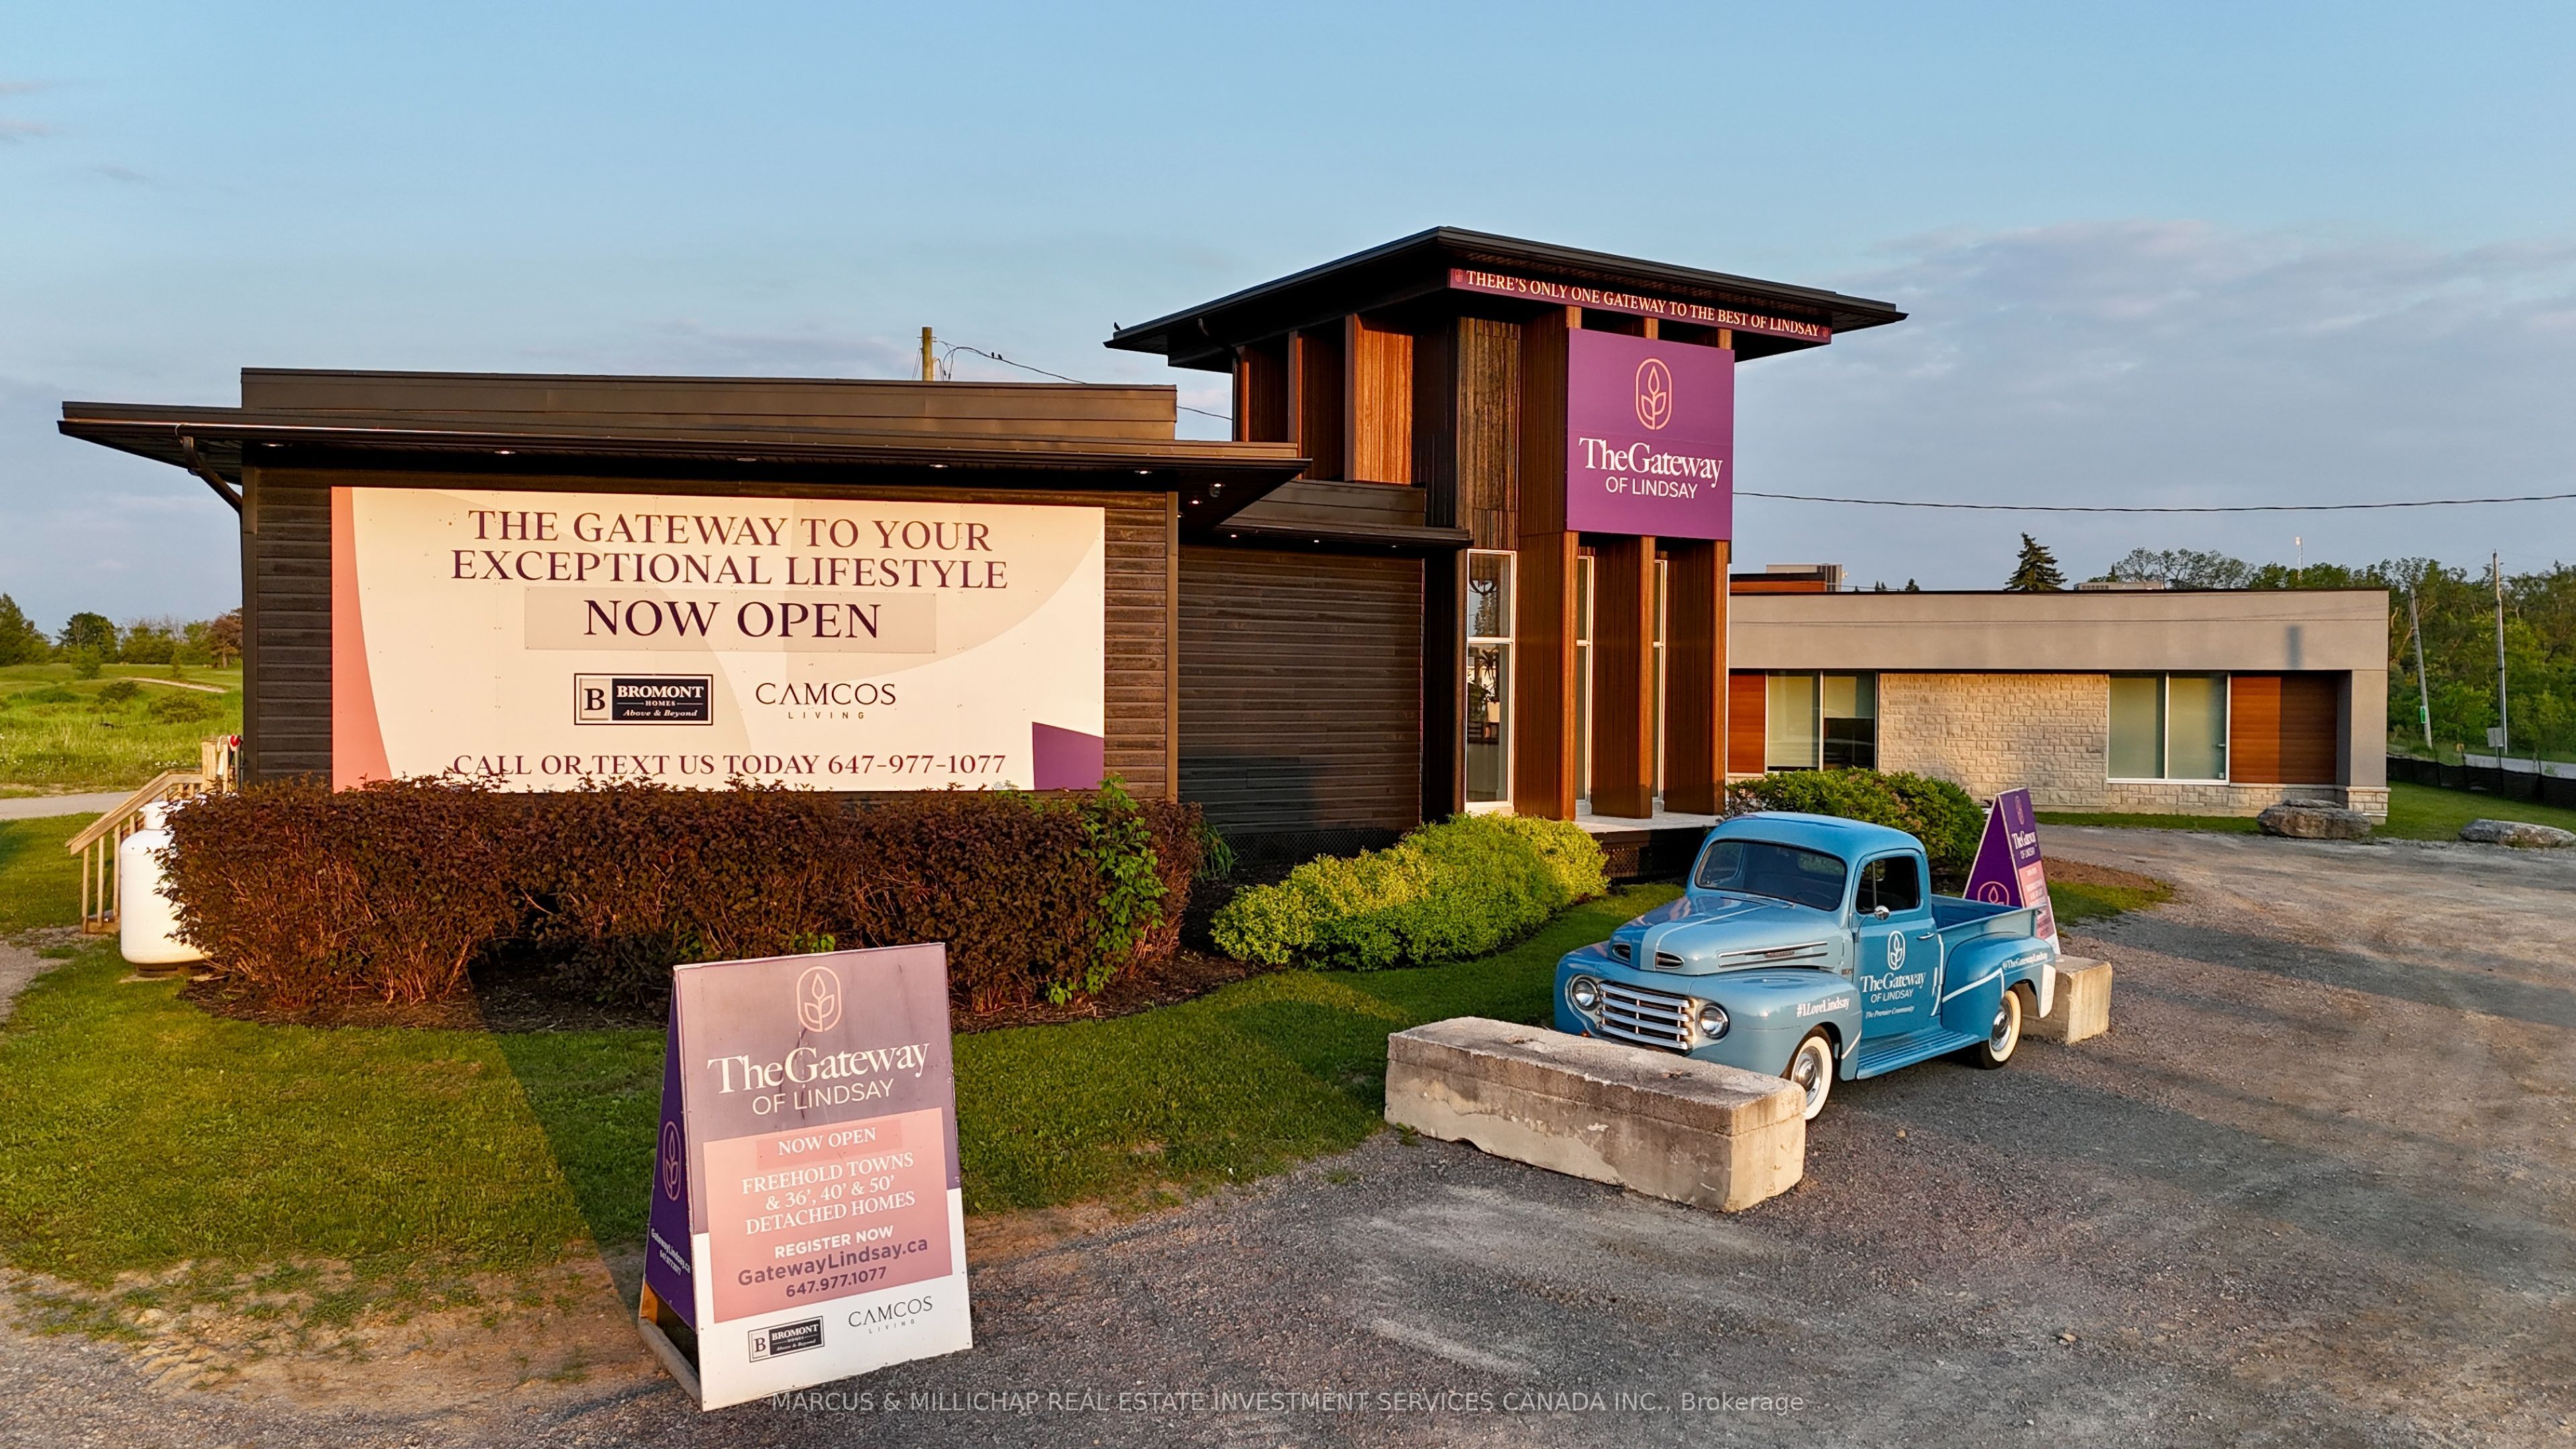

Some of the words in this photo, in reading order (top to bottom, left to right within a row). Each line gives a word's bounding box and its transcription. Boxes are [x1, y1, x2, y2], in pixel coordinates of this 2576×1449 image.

[1466, 270, 1526, 292] THERE'S
[1530, 280, 1568, 299] ONLY
[1571, 286, 1600, 304] ONE
[1603, 291, 1666, 314] GATEWAY
[1669, 301, 1687, 317] TO
[1690, 304, 1715, 321] THE
[1717, 309, 1748, 326] BEST
[1751, 315, 1768, 329] OF
[1770, 317, 1819, 337] LINDSAY
[1578, 437, 1723, 488] TheGateway
[1605, 476, 1628, 493] OF
[1632, 478, 1698, 499] LINDSAY
[468, 510, 559, 541] THE
[574, 512, 788, 547] GATEWAY
[800, 518, 859, 548] TO
[872, 520, 993, 551] YOUR
[451, 549, 772, 584] EXCEPTIONAL
[786, 557, 1008, 589] LIFESTYLE
[583, 600, 721, 637] NOW
[737, 601, 881, 638] OPEN
[584, 688, 605, 710] B
[616, 686, 704, 698] BROMONT
[755, 682, 896, 705] CAMCOS
[663, 709, 698, 718] Beyond
[788, 711, 864, 719] LIVING
[453, 755, 532, 775] CALL
[541, 755, 585, 775] OR
[592, 755, 669, 775] TEXT
[678, 755, 714, 774] US
[722, 755, 820, 774] TODAY
[828, 755, 1006, 774] 647-977-1077
[1860, 972, 1927, 993] TheGateway
[1870, 993, 1882, 1004] OF
[1882, 988, 1914, 1002] LINDSAY
[706, 1042, 930, 1095] TheGateway
[752, 1093, 786, 1116] OF
[794, 1078, 894, 1110] LINDSAY
[778, 1135, 824, 1156] NOW
[828, 1127, 876, 1148] OPEN
[741, 1164, 843, 1195] FREEHOLD
[847, 1152, 914, 1177] TOWNS
[765, 1195, 780, 1211] &
[851, 1181, 865, 1196] &
[745, 1203, 847, 1235] DETACHED
[851, 1191, 916, 1216] HOMES
[774, 1234, 851, 1259] REGISTER
[856, 1225, 894, 1244] NOW
[738, 1238, 928, 1286] GatewayLindsay.ca
[786, 1267, 887, 1297] 647.977.1077
[849, 1295, 932, 1327] CAMCOS
[754, 1338, 766, 1352] B
[771, 1324, 819, 1341] BROMONT
